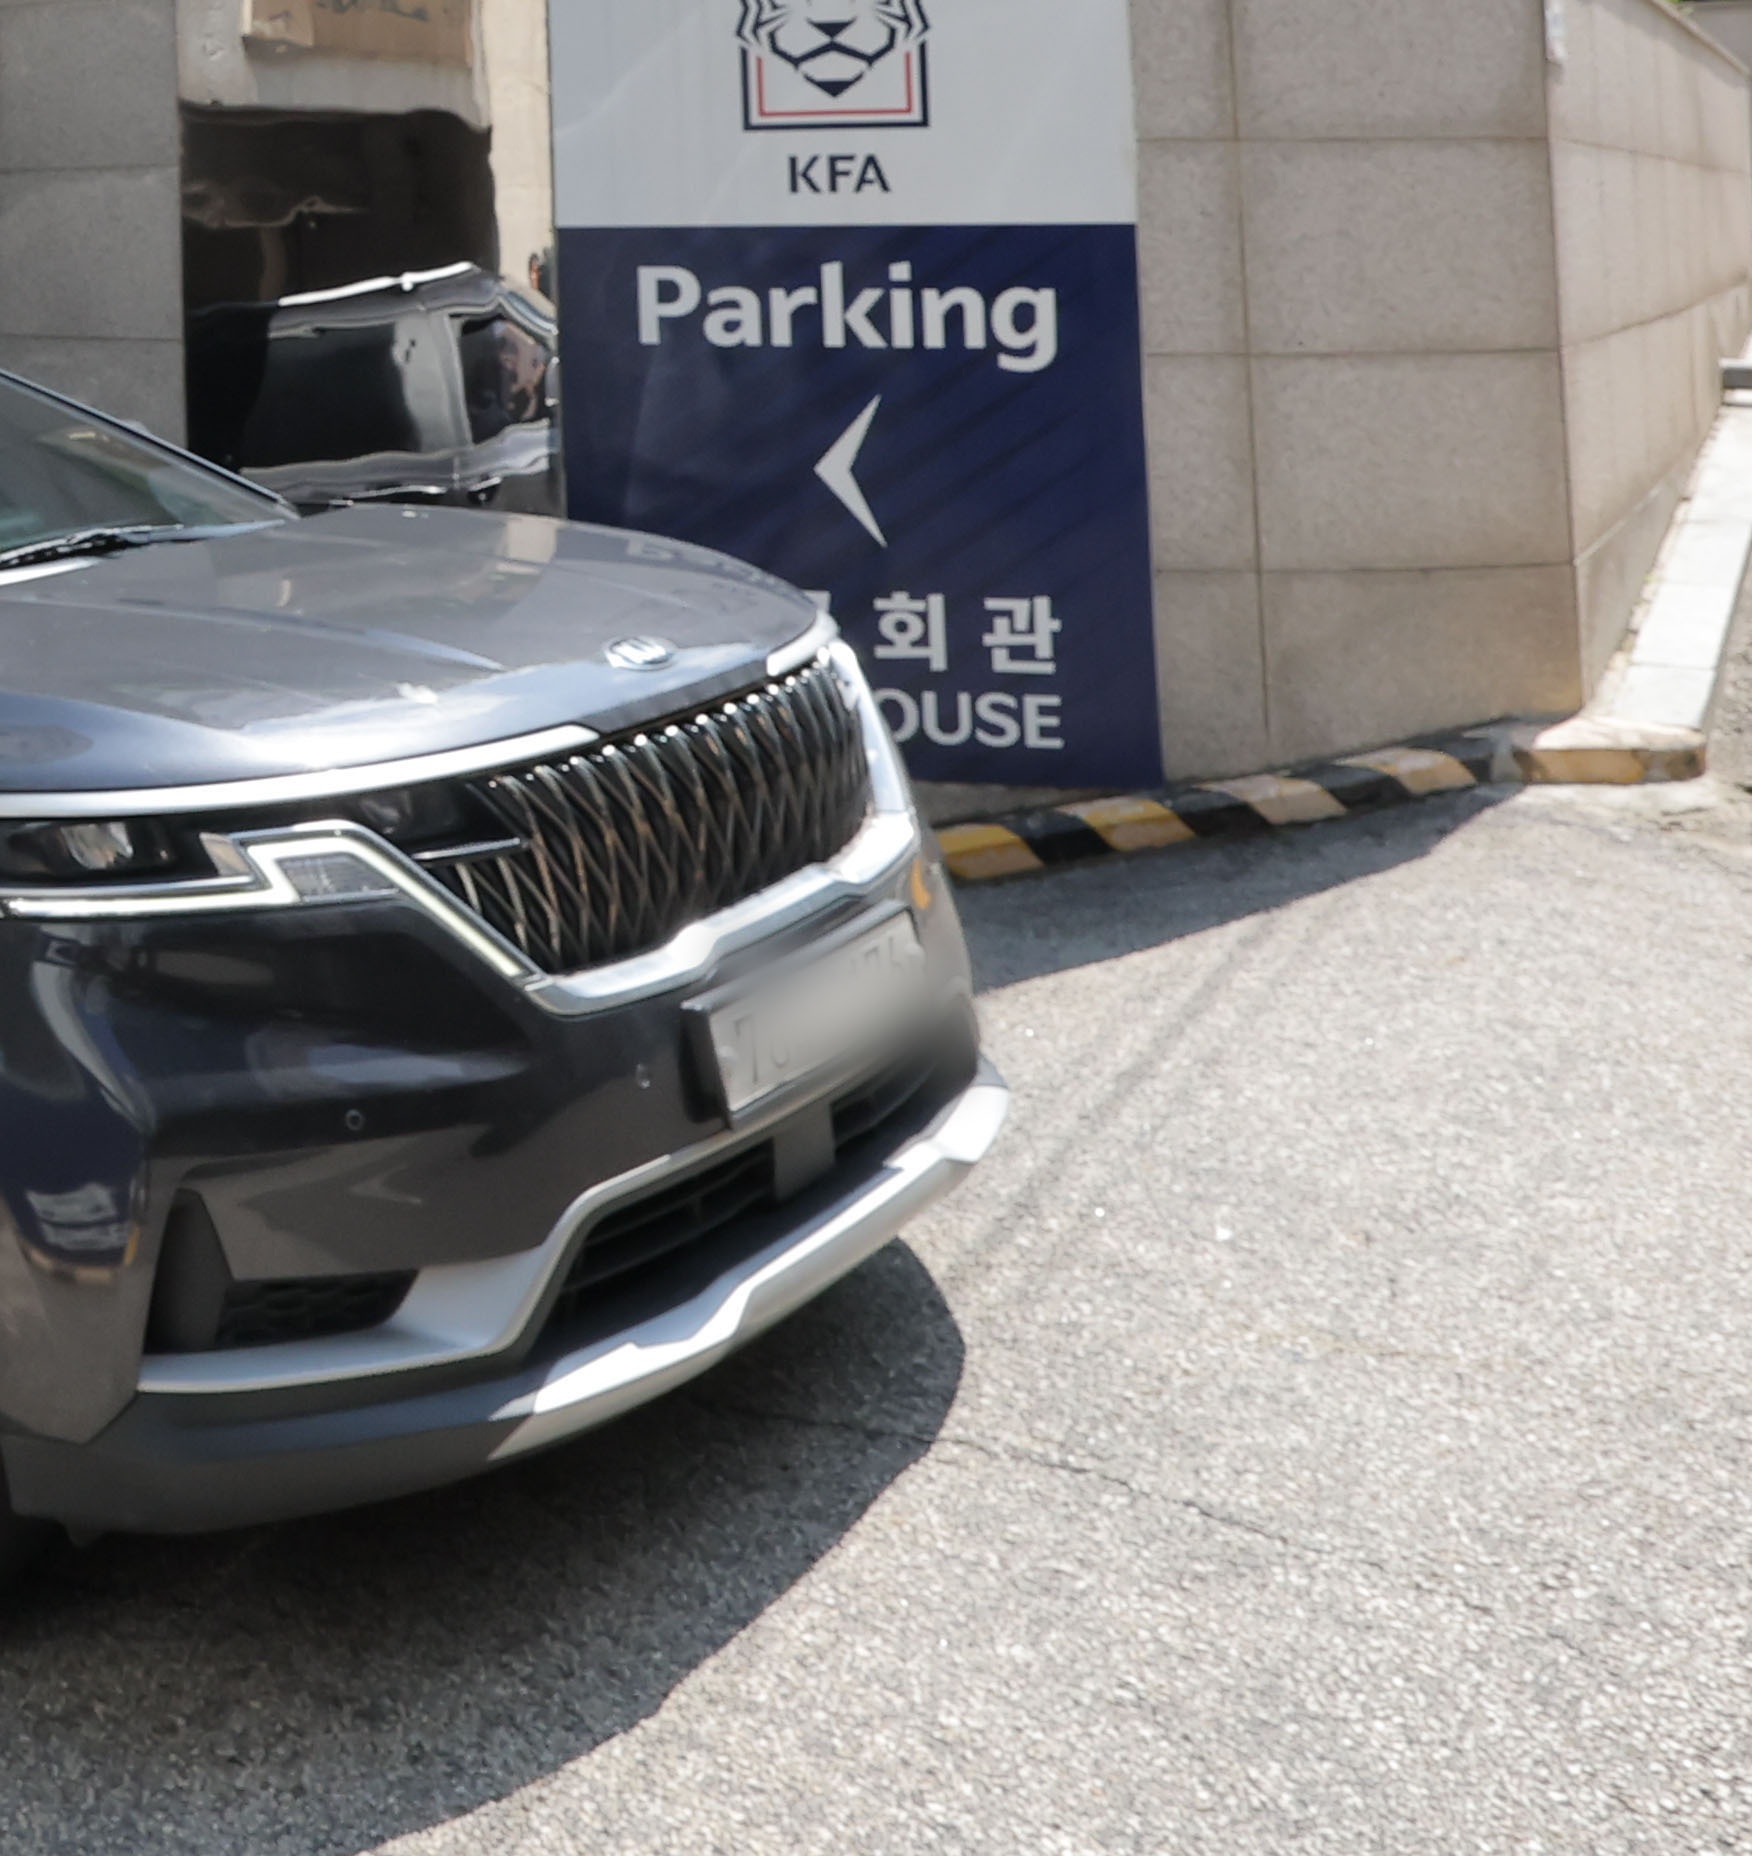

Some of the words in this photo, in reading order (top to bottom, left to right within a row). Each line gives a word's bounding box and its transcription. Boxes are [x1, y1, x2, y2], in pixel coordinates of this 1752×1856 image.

[787, 154, 891, 194] KFA
[636, 260, 1058, 373] Parking
[874, 687, 1065, 749] OUSE
